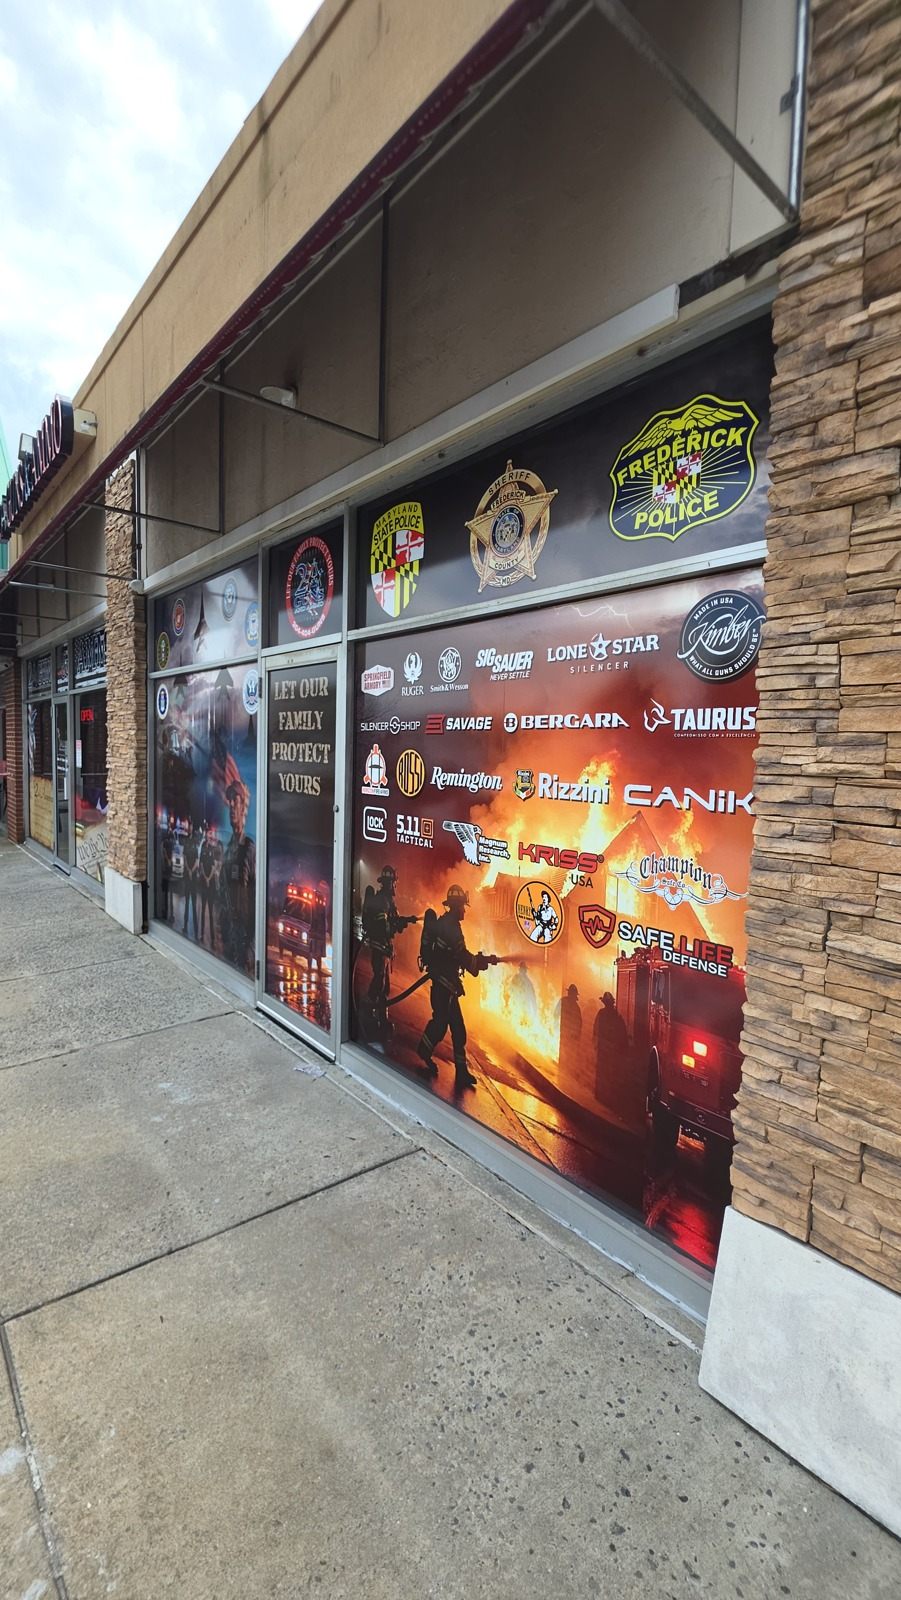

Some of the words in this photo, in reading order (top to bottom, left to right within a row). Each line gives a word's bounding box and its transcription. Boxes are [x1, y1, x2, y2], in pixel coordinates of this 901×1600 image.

[616, 426, 748, 487] FREDERICK
[488, 471, 531, 496] SHERIFF
[492, 491, 524, 509] FREDERICK
[633, 489, 720, 530] POLICE
[375, 504, 418, 530] MARYLAND
[373, 519, 394, 546] STATE
[394, 514, 421, 529] POLICE
[326, 555, 334, 586] YOURS
[494, 558, 519, 570] COUNTY
[501, 577, 511, 585] MD
[693, 603, 711, 621] MADE
[711, 600, 719, 608] IN
[677, 604, 767, 659] Kimber
[475, 648, 497, 668] SIG
[492, 650, 534, 673] SAUER
[547, 644, 588, 663] LONE
[612, 634, 660, 655] STAR
[689, 655, 703, 670] WHAT
[702, 668, 713, 676] ALL
[715, 667, 734, 676] GUNS
[734, 645, 756, 671] SHOULD
[752, 633, 759, 643] BE
[364, 670, 391, 682] SPRINGFIELD
[490, 673, 508, 681] NEVER
[509, 671, 530, 680] SETTLE
[569, 661, 630, 674] SILENCER
[274, 681, 297, 701] LET
[300, 676, 329, 698] OUR
[401, 685, 424, 697] RUGER
[278, 711, 323, 730] FAMILY
[360, 722, 389, 732] SILENCER
[400, 721, 420, 731] SHOP
[446, 716, 493, 730] SAVAGE
[521, 712, 630, 730] BERGARA
[670, 706, 757, 731] TAURUS
[272, 742, 331, 764] PROTECT
[278, 772, 321, 796] YOURS
[399, 751, 423, 794] ROSSI
[430, 766, 503, 792] Remington
[538, 772, 611, 804] Rizzini
[396, 814, 421, 836] 5.11
[396, 834, 433, 849] TACTICAL
[479, 846, 510, 859] Research,
[480, 836, 508, 848] Magnum
[570, 874, 594, 889] USA
[640, 853, 712, 890] Champion
[618, 921, 675, 951] SAFE
[679, 935, 733, 967] LIFE
[662, 949, 728, 978] DEFENSE
